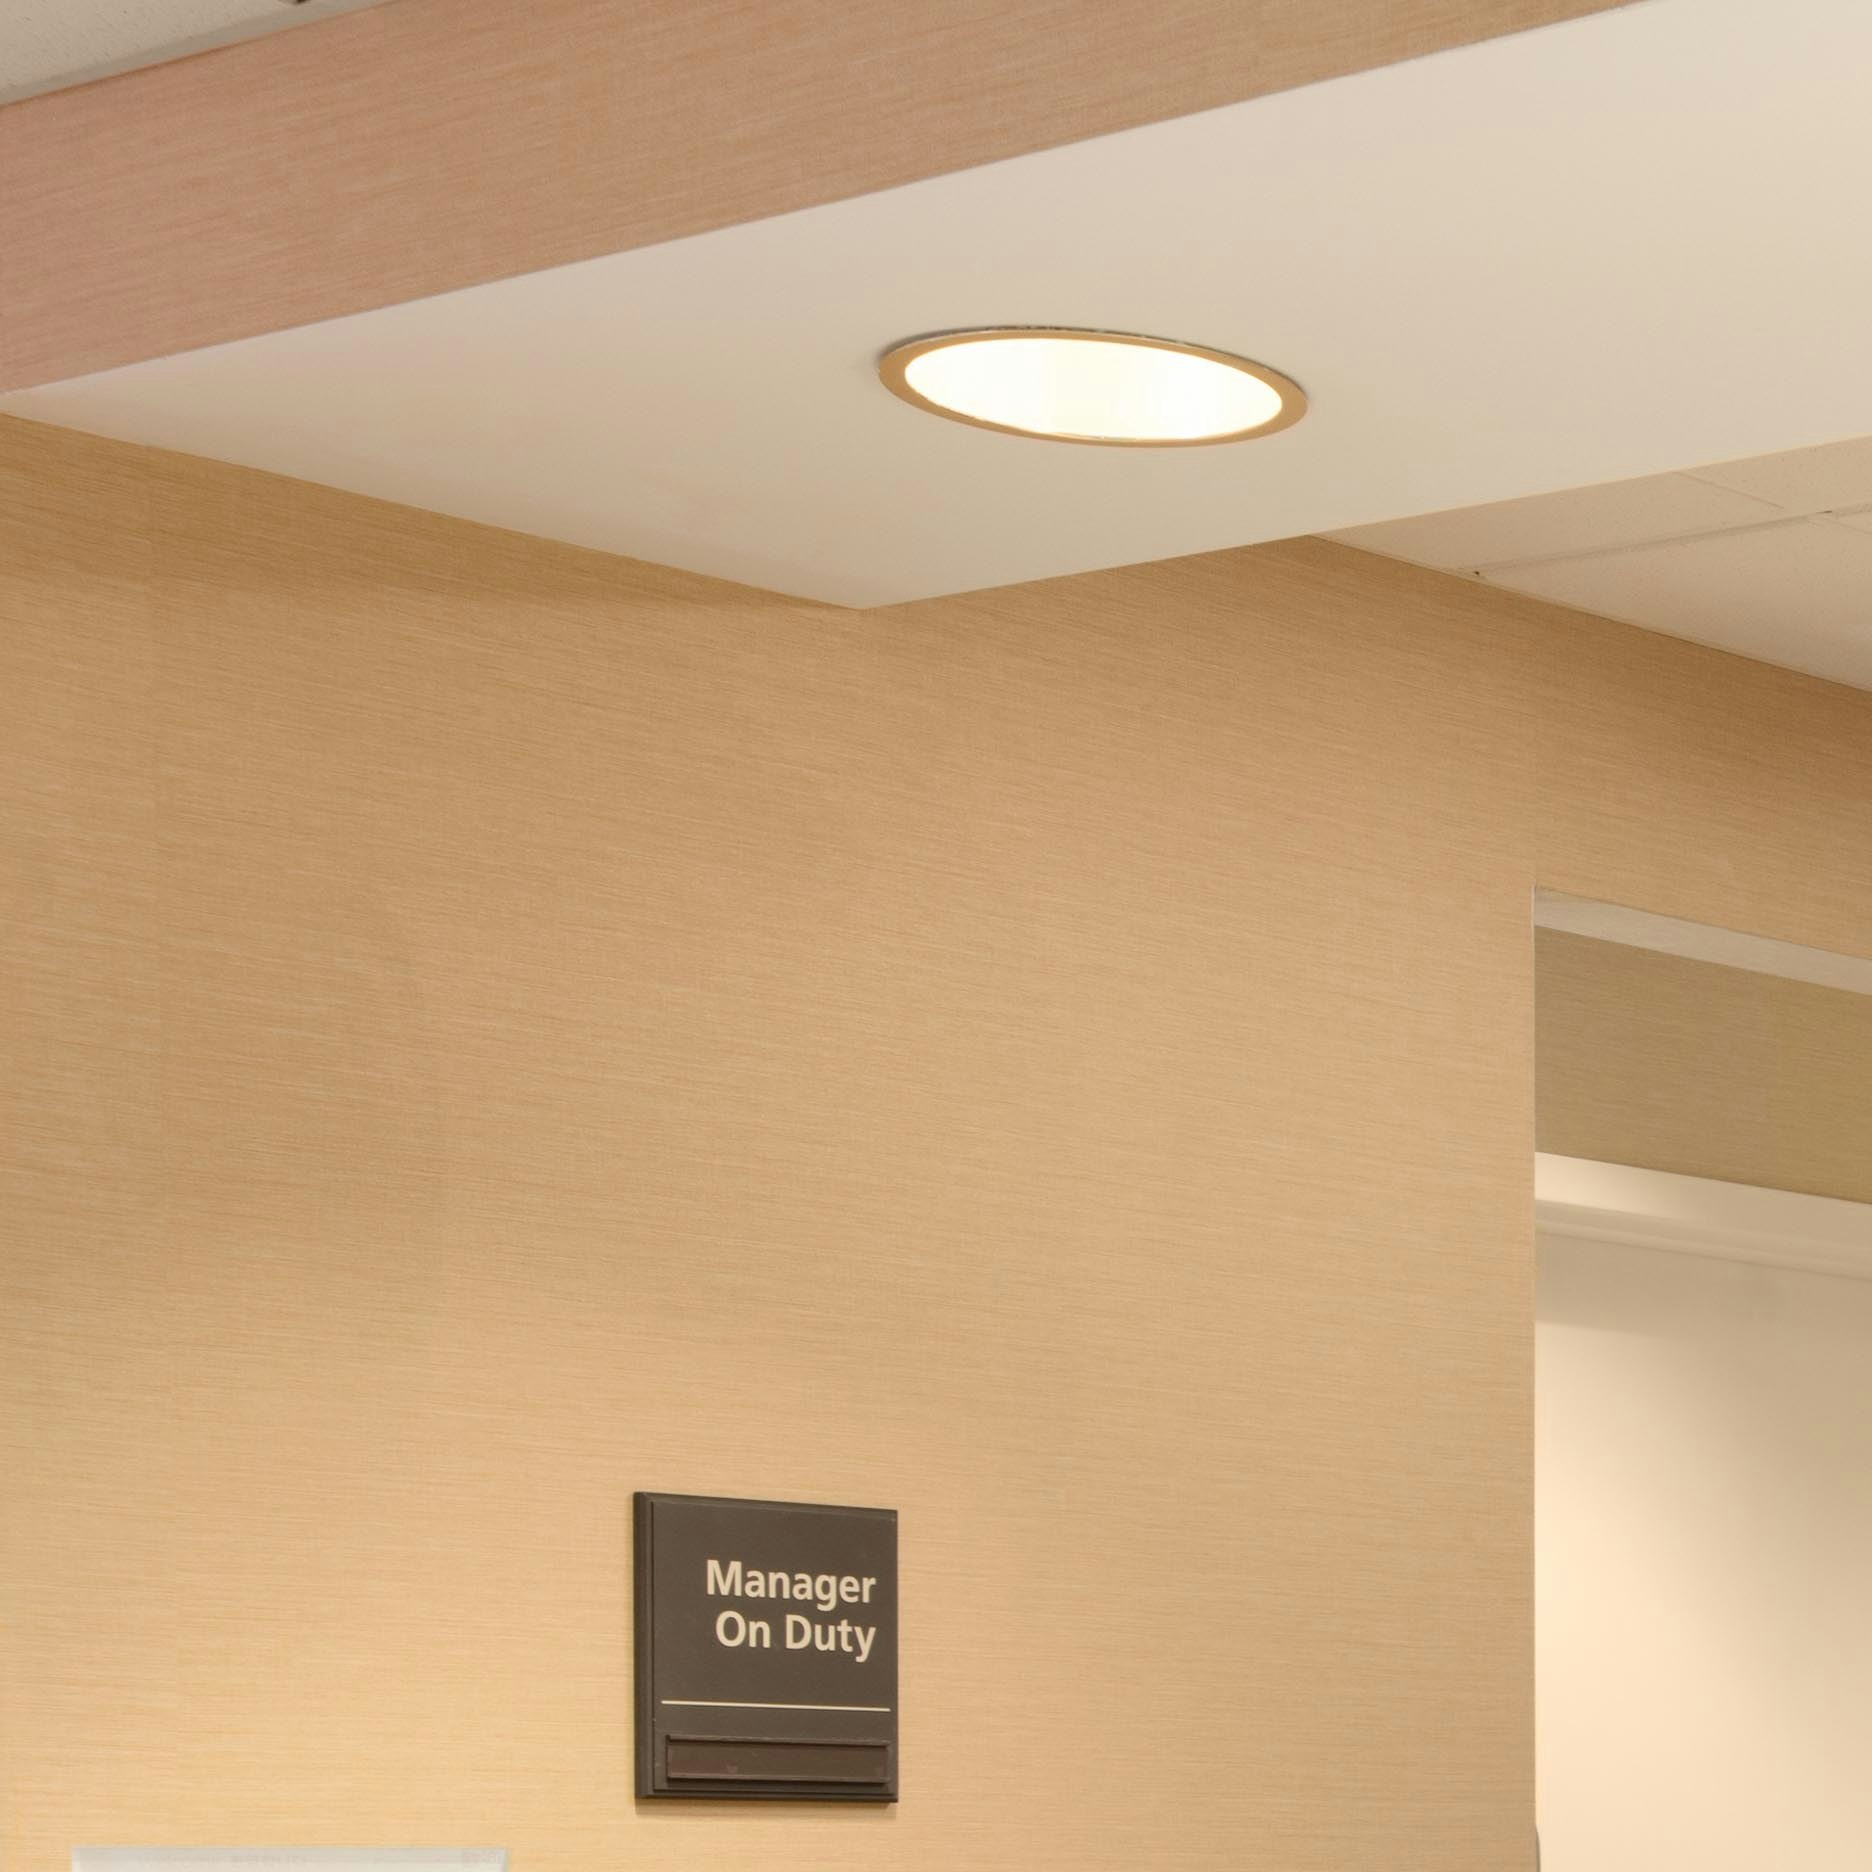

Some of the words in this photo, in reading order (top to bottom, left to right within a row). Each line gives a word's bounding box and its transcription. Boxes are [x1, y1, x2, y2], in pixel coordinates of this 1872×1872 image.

[706, 1559, 877, 1612] Manager
[716, 1610, 771, 1648] On
[785, 1614, 877, 1663] Duty
